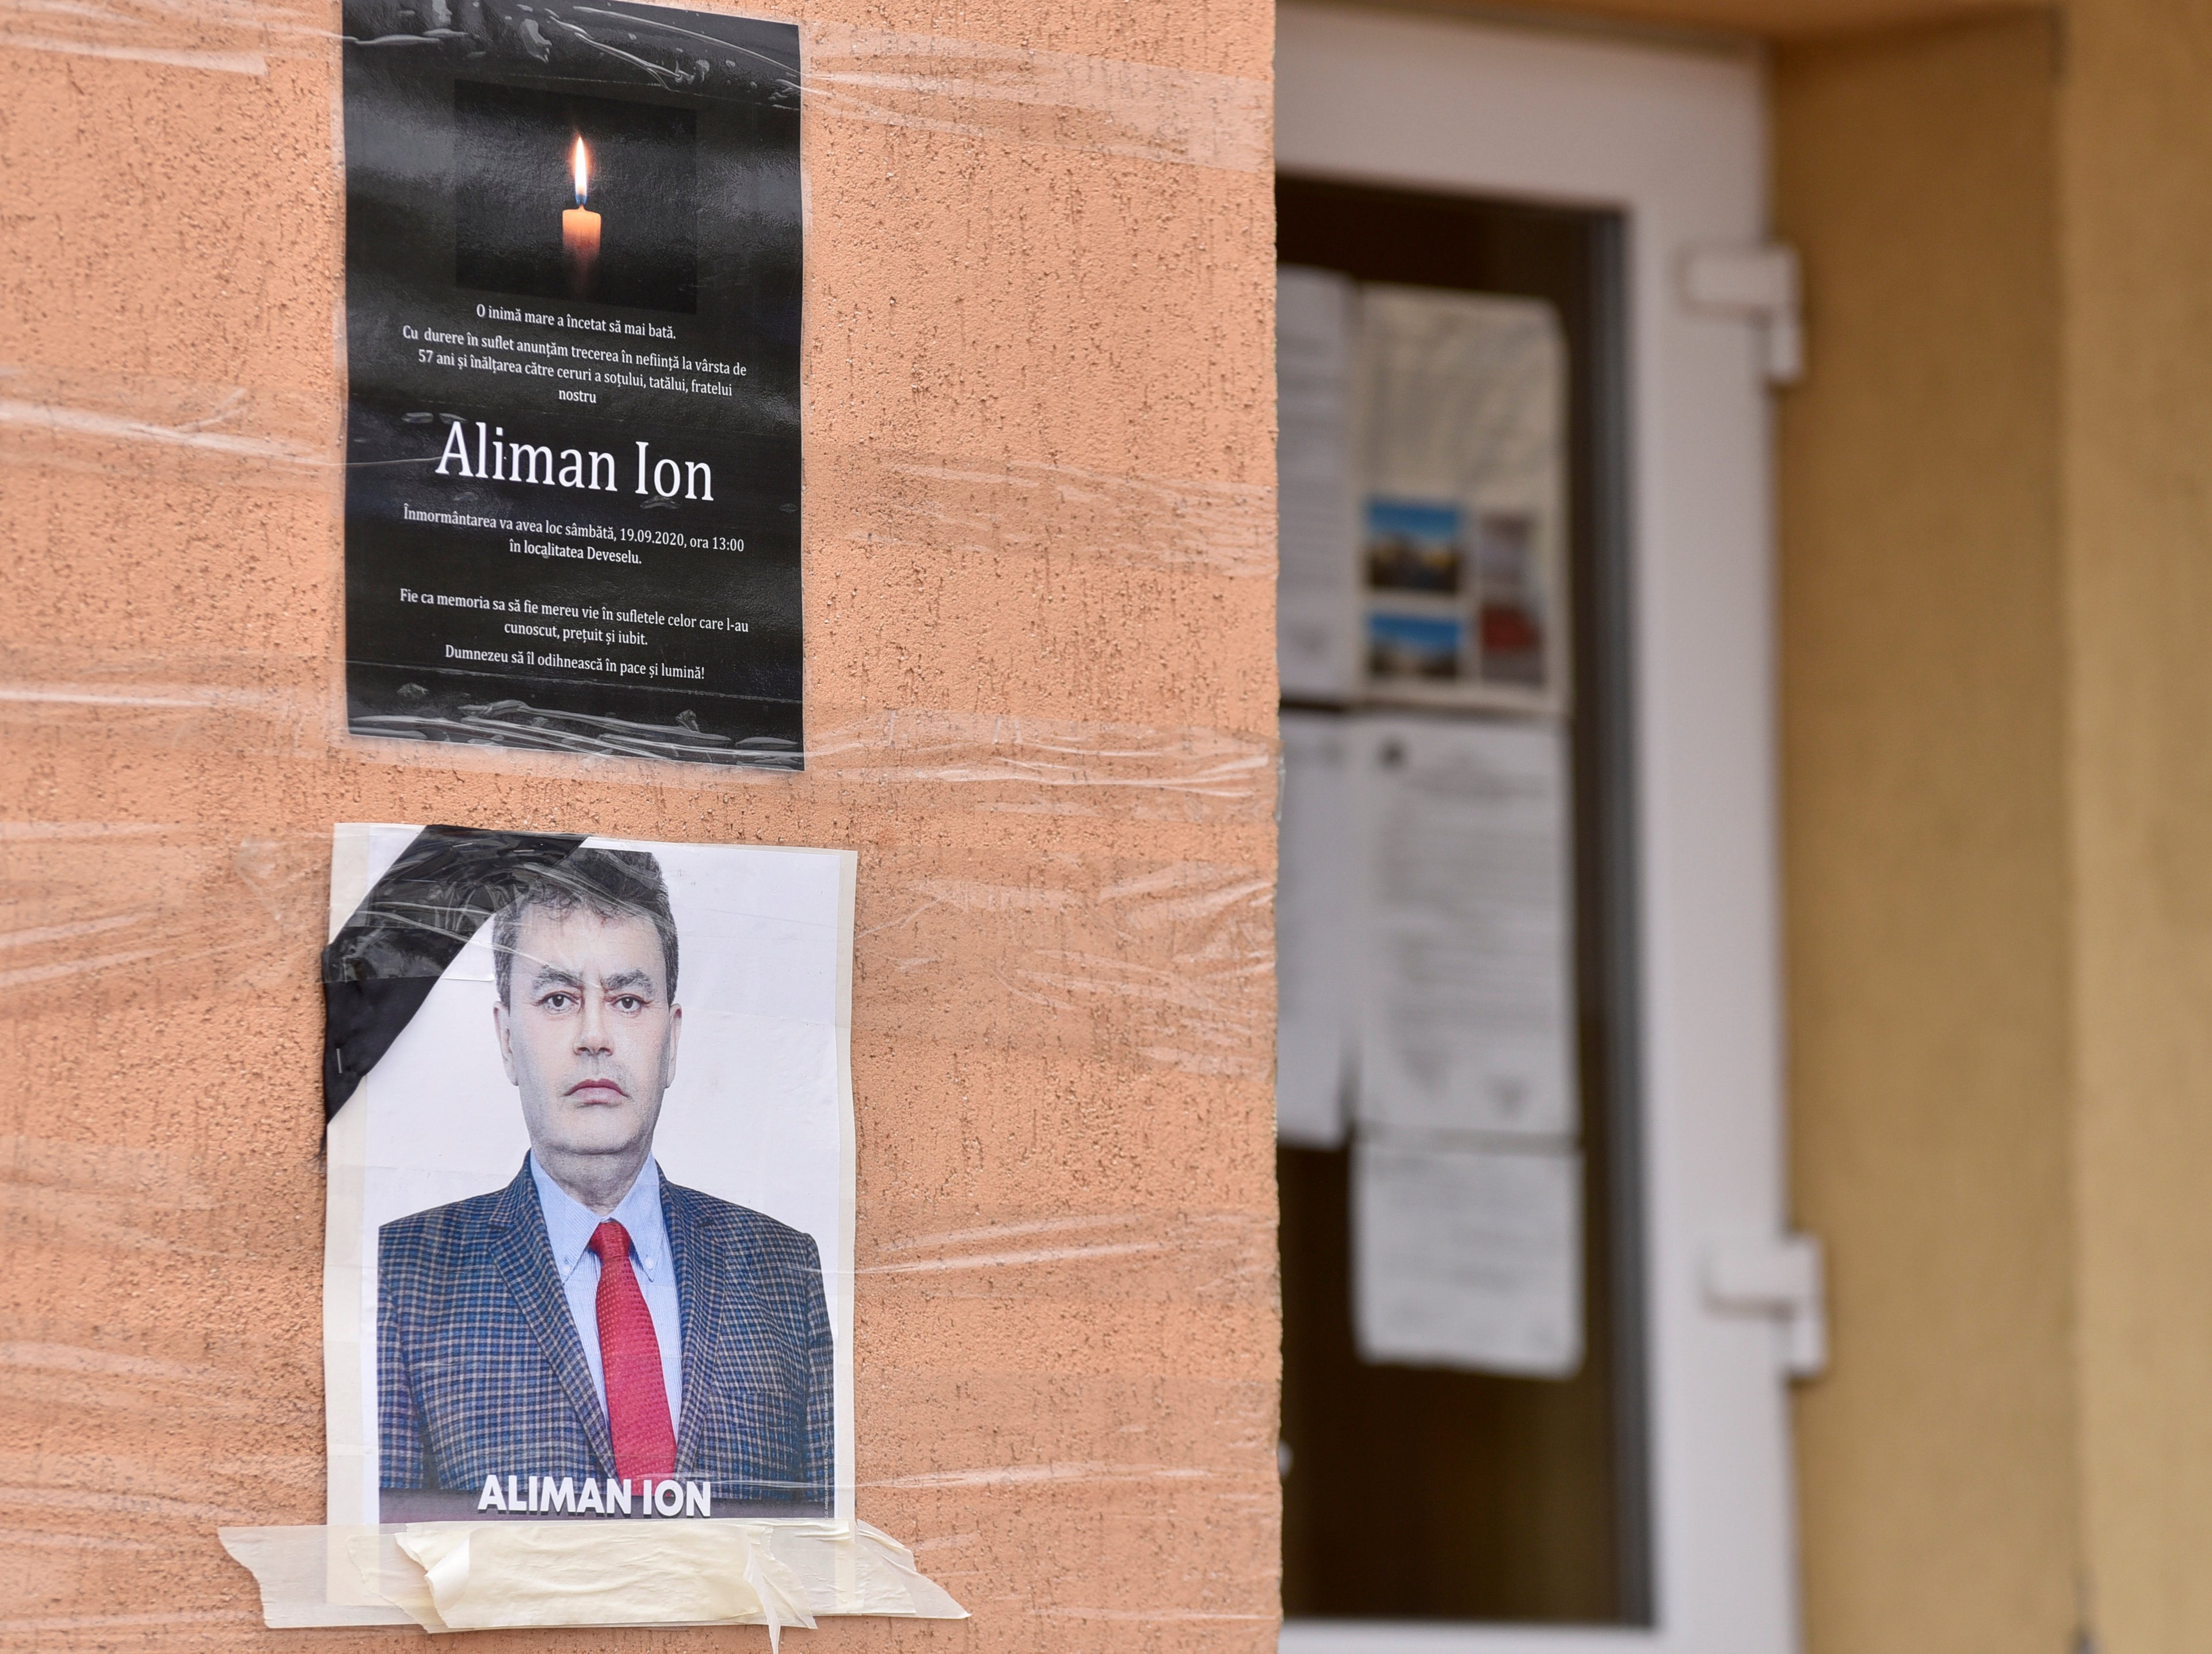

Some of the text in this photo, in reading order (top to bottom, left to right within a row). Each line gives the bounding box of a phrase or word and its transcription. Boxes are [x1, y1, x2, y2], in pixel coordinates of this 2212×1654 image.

[476, 303, 676, 339] O inimă mare a încetat să mai bată.
[402, 324, 746, 376] Cu durere în suflet anunțăm trecerea în neființă la vârsta de
[418, 348, 732, 396] 57 ani și înălțarea către ceruri a soțului, tatălui, fratelui
[558, 389, 596, 403] nostru
[434, 420, 714, 501] Aliman Ion
[403, 502, 744, 551] Înmormântarea va avea loc sâmbătă, 19.09.2020, ora 13:00
[509, 537, 642, 564] în localitatea Deveselu.
[400, 587, 748, 632] Fie ca memoria sa să fie mereu vie în sufletele celor care l-au
[504, 623, 647, 645] cunoscut, prețuit și iubit.
[445, 644, 704, 679] Dumnezeu să îl odihnească în pace și lumină!
[477, 1475, 711, 1518] ALIMAN ION
